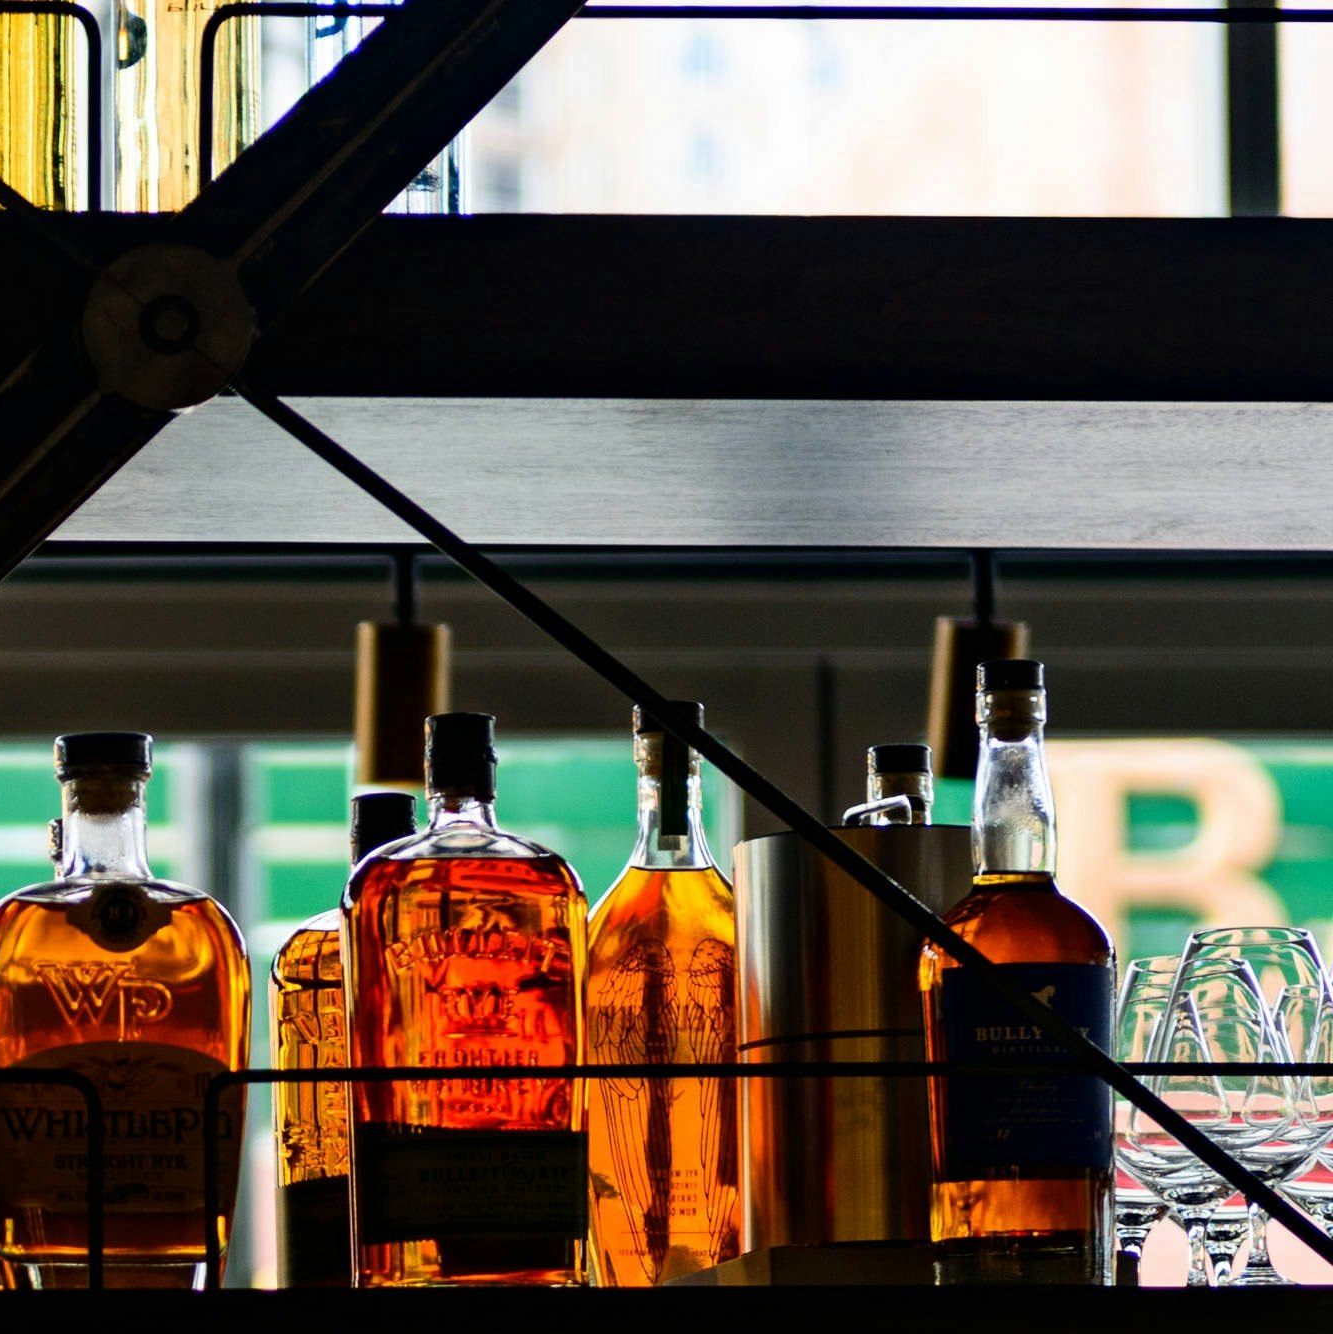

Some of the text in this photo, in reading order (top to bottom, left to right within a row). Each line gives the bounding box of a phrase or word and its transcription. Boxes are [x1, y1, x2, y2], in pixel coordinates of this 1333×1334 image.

[975, 1025, 1044, 1042] BULLY
[0, 1107, 232, 1142] WHITLEPG
[54, 1153, 188, 1170] STRIGHT RYE
